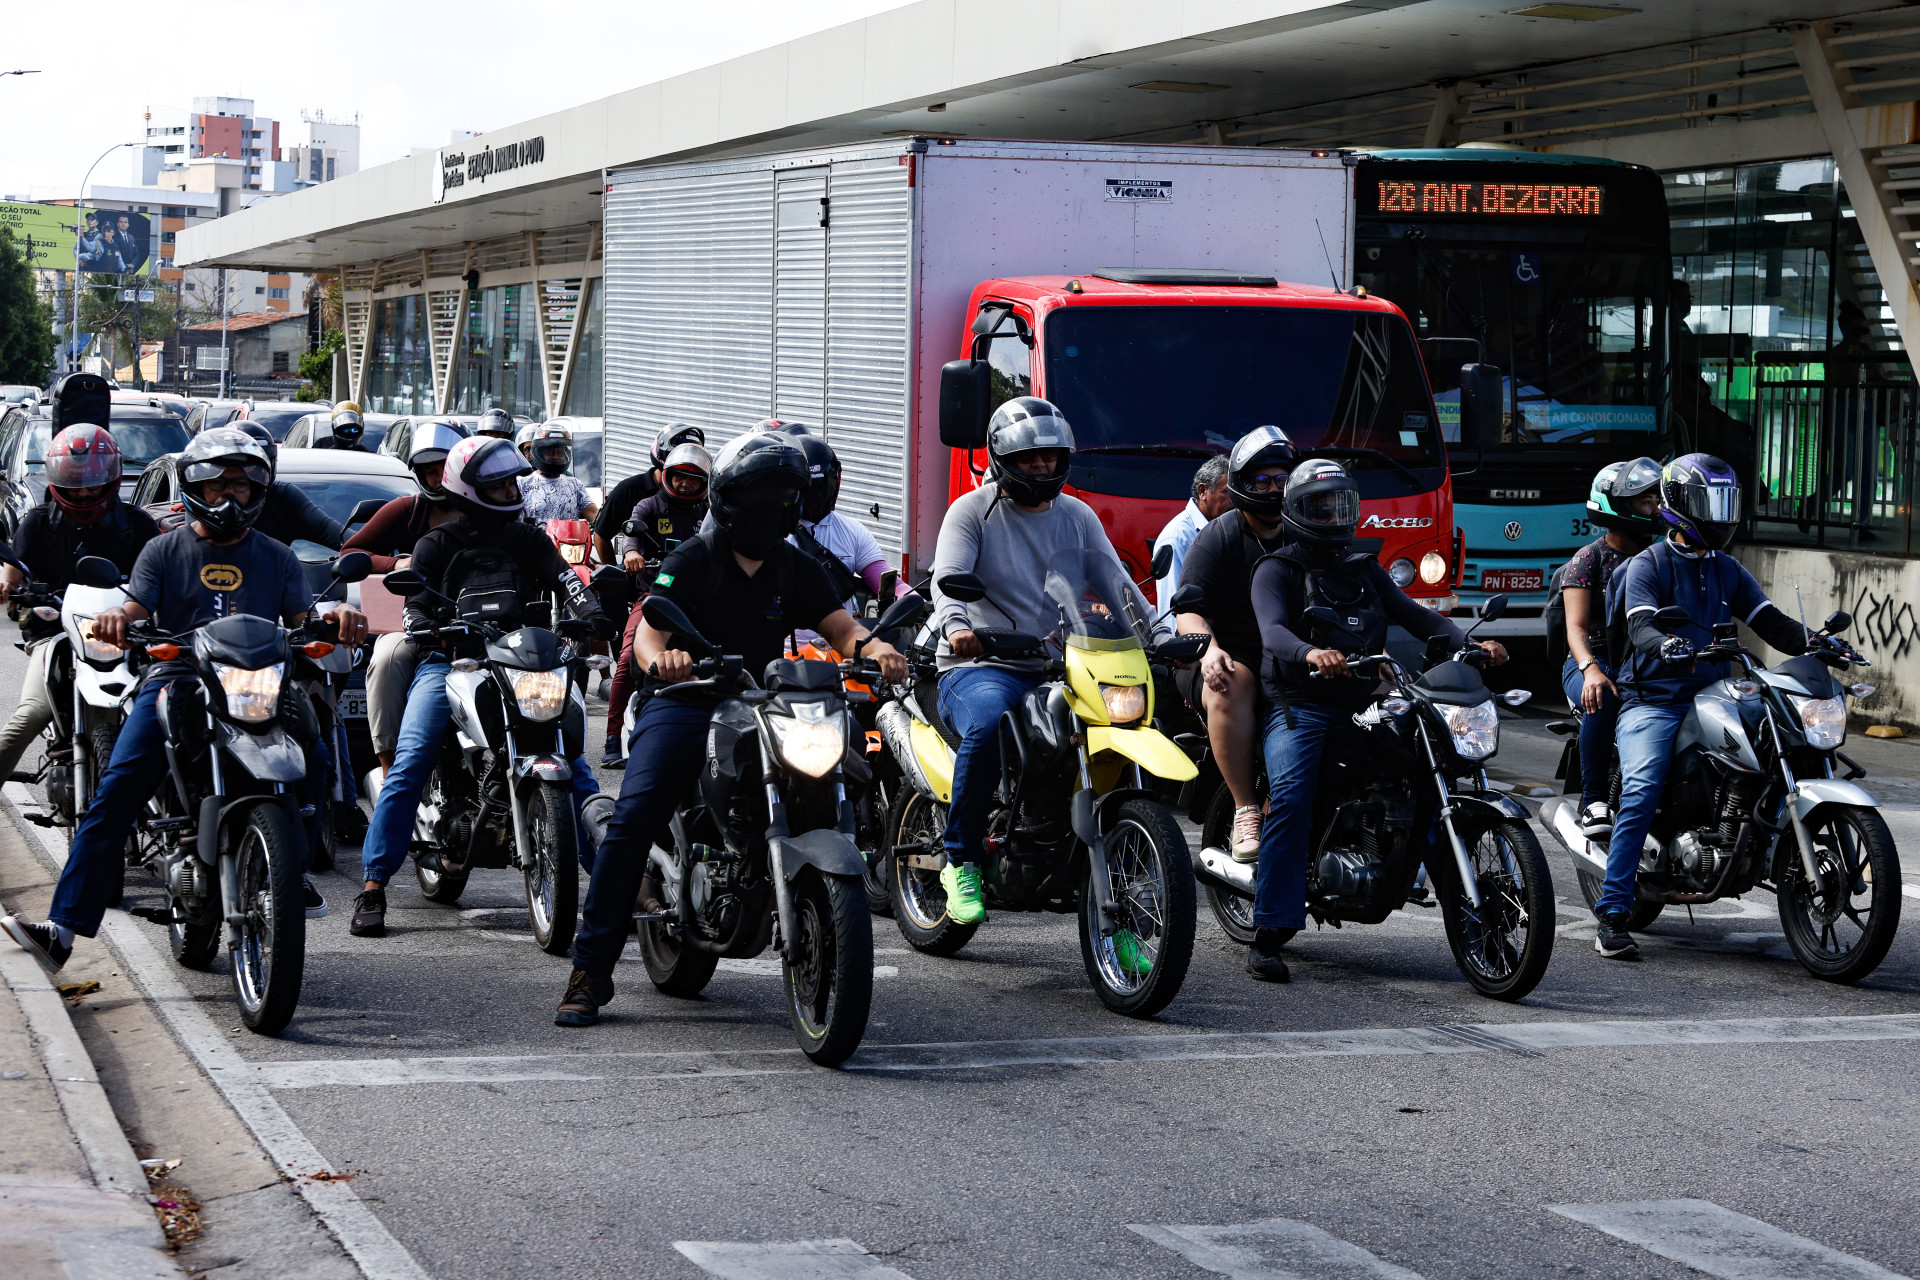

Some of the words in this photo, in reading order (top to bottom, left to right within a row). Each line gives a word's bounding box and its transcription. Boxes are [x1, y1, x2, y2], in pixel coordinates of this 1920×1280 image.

[468, 145, 493, 183] ESTAÇÃO
[494, 143, 518, 173] JORNAL
[519, 141, 524, 167] O
[525, 136, 544, 165] POVO
[1378, 182, 1416, 211] 126
[1423, 183, 1478, 213] ANT.
[1483, 184, 1600, 214] BEZERRA
[20, 207, 42, 216] TOTAL
[1552, 412, 1567, 422] AR
[1569, 412, 1655, 424] CONDICIONADO
